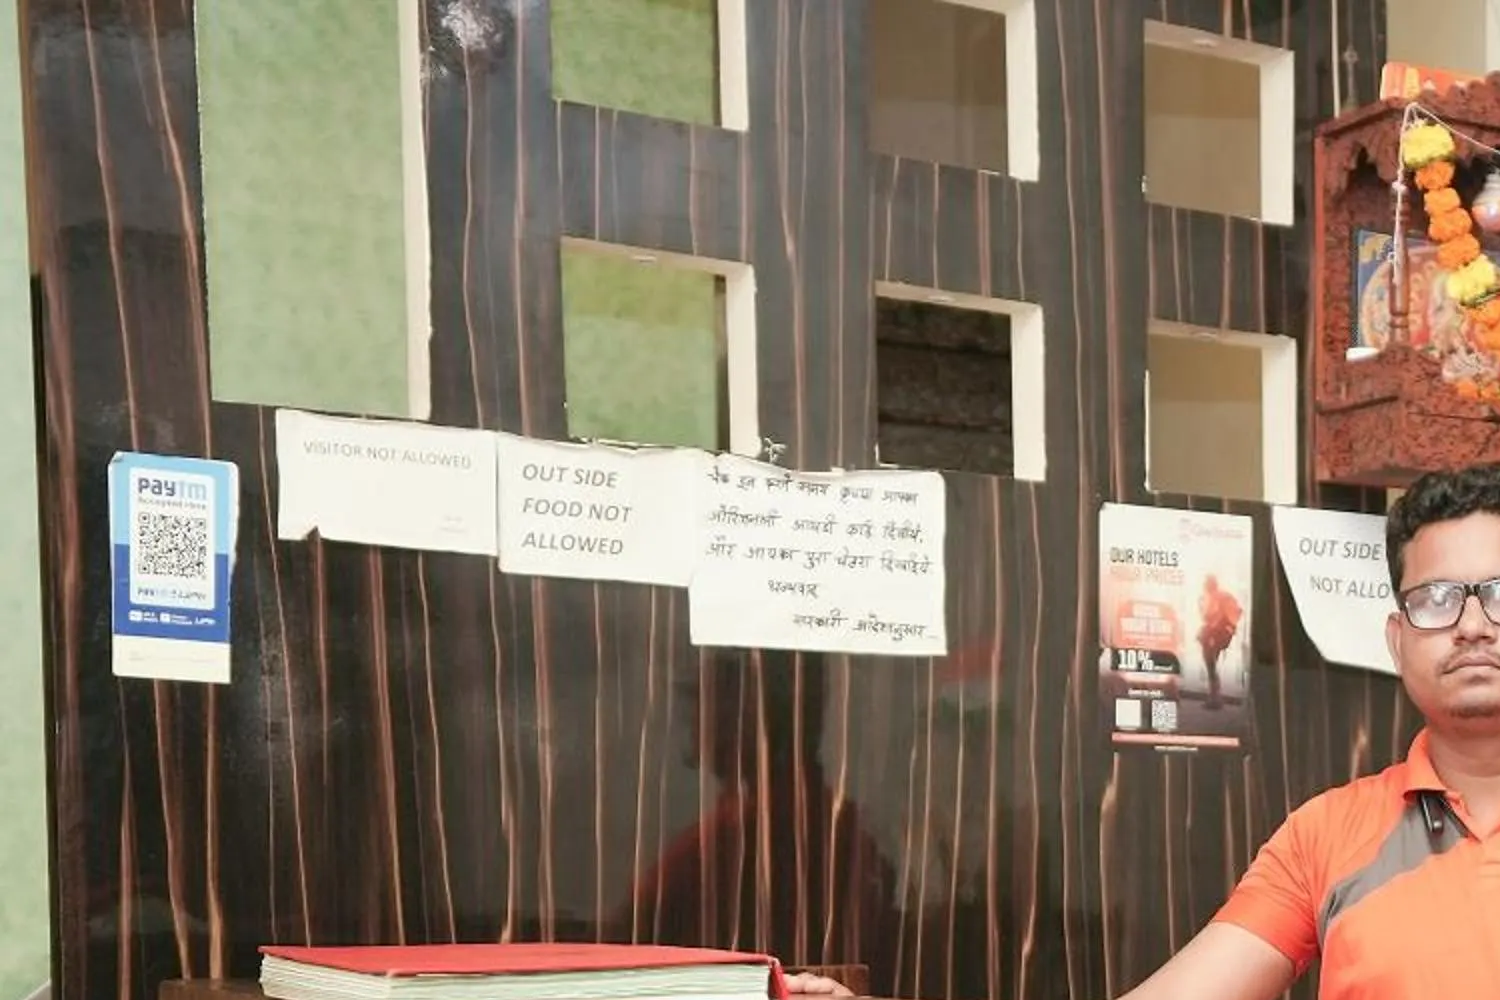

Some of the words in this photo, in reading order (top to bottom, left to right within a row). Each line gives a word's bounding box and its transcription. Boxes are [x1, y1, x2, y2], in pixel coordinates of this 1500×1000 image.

[303, 440, 362, 457] VISITOR
[367, 446, 396, 462] NOT
[402, 451, 472, 469] ALLOWED
[522, 463, 568, 482] OUT
[573, 468, 619, 488] SIDE
[522, 497, 583, 518] FOOD
[588, 503, 632, 523] NOT
[521, 531, 624, 555] ALLOWED
[1299, 536, 1339, 557] OUT
[1343, 541, 1382, 561] SIDE
[1110, 546, 1135, 563] OUR
[1137, 549, 1179, 568] HOTELS
[1310, 574, 1343, 594] NOT
[1117, 648, 1155, 671] 10%
